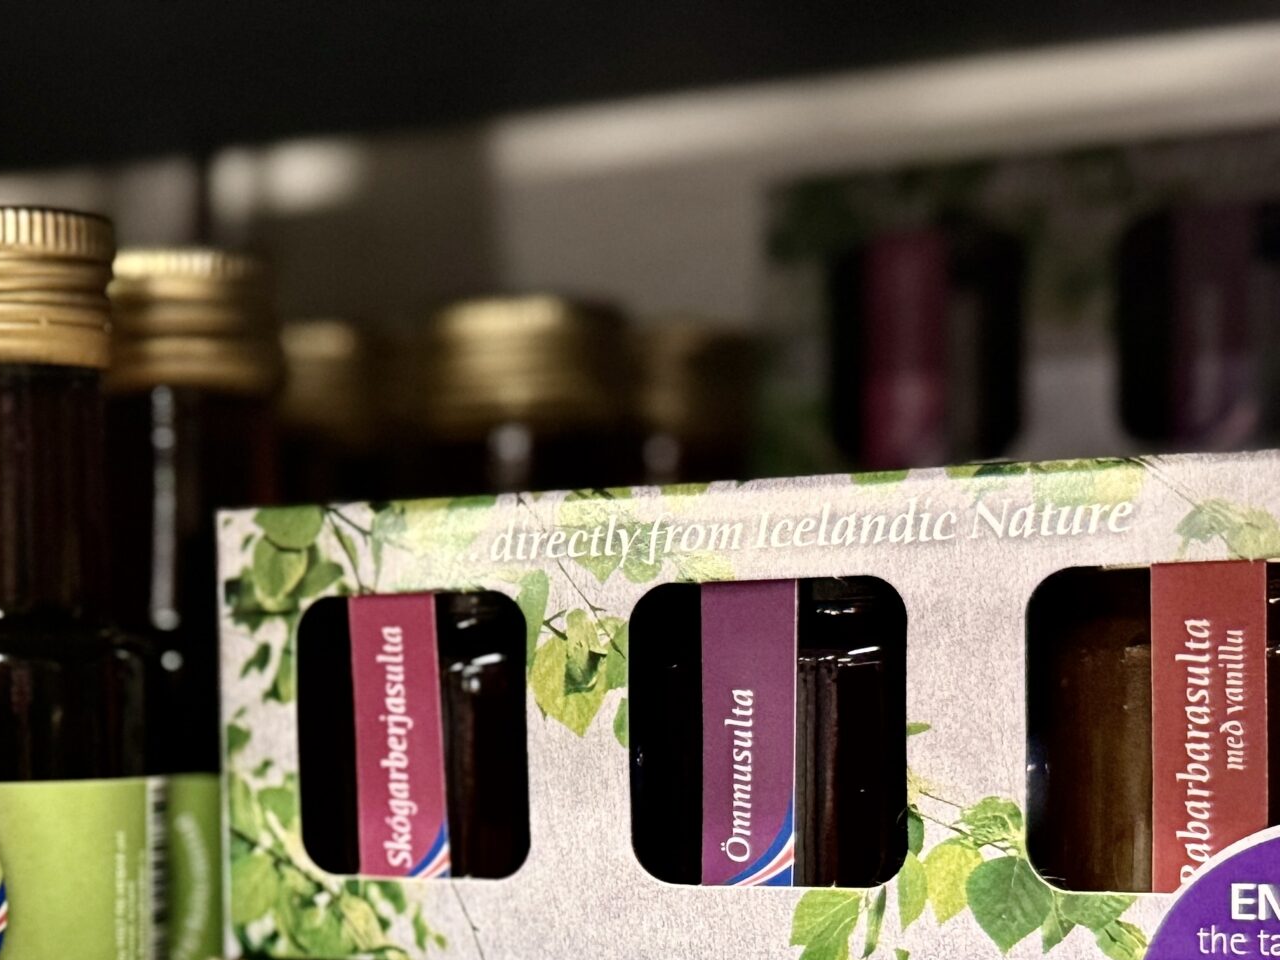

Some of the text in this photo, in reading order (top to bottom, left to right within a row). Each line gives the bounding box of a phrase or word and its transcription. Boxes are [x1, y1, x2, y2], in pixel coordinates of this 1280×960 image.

[490, 514, 634, 568] directly
[636, 513, 740, 564] from
[753, 502, 956, 549] Icelandic
[968, 493, 1133, 540] Nature
[375, 626, 418, 868] Skógarberjasulta
[1218, 629, 1246, 771] með vanillu
[720, 689, 755, 863] Ömmusulta
[1196, 925, 1249, 955] the
